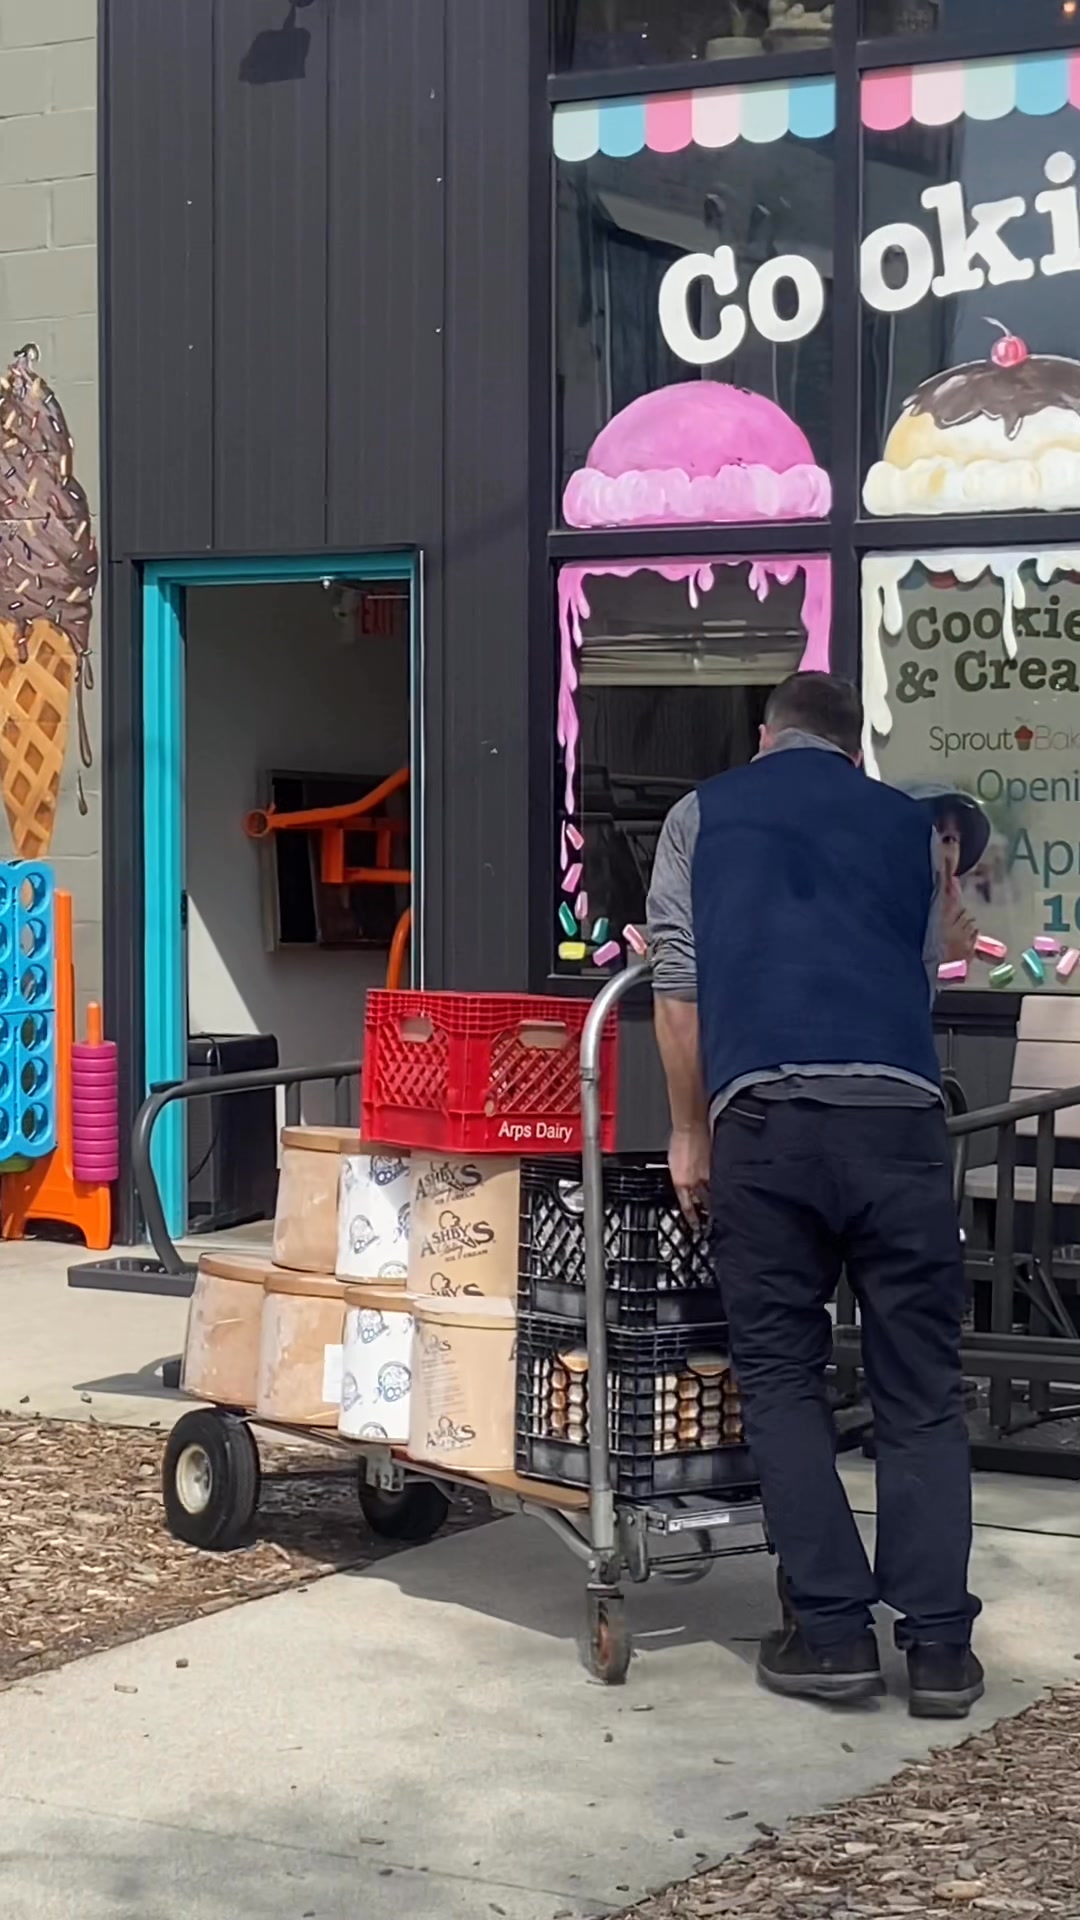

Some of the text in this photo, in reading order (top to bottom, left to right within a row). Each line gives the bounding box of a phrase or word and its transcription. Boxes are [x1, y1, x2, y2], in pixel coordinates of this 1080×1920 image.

[896, 650, 1080, 703] & Crea
[929, 726, 1013, 758] Sprout
[1007, 828, 1080, 888] Ap
[498, 1121, 573, 1143] Arps Dairy
